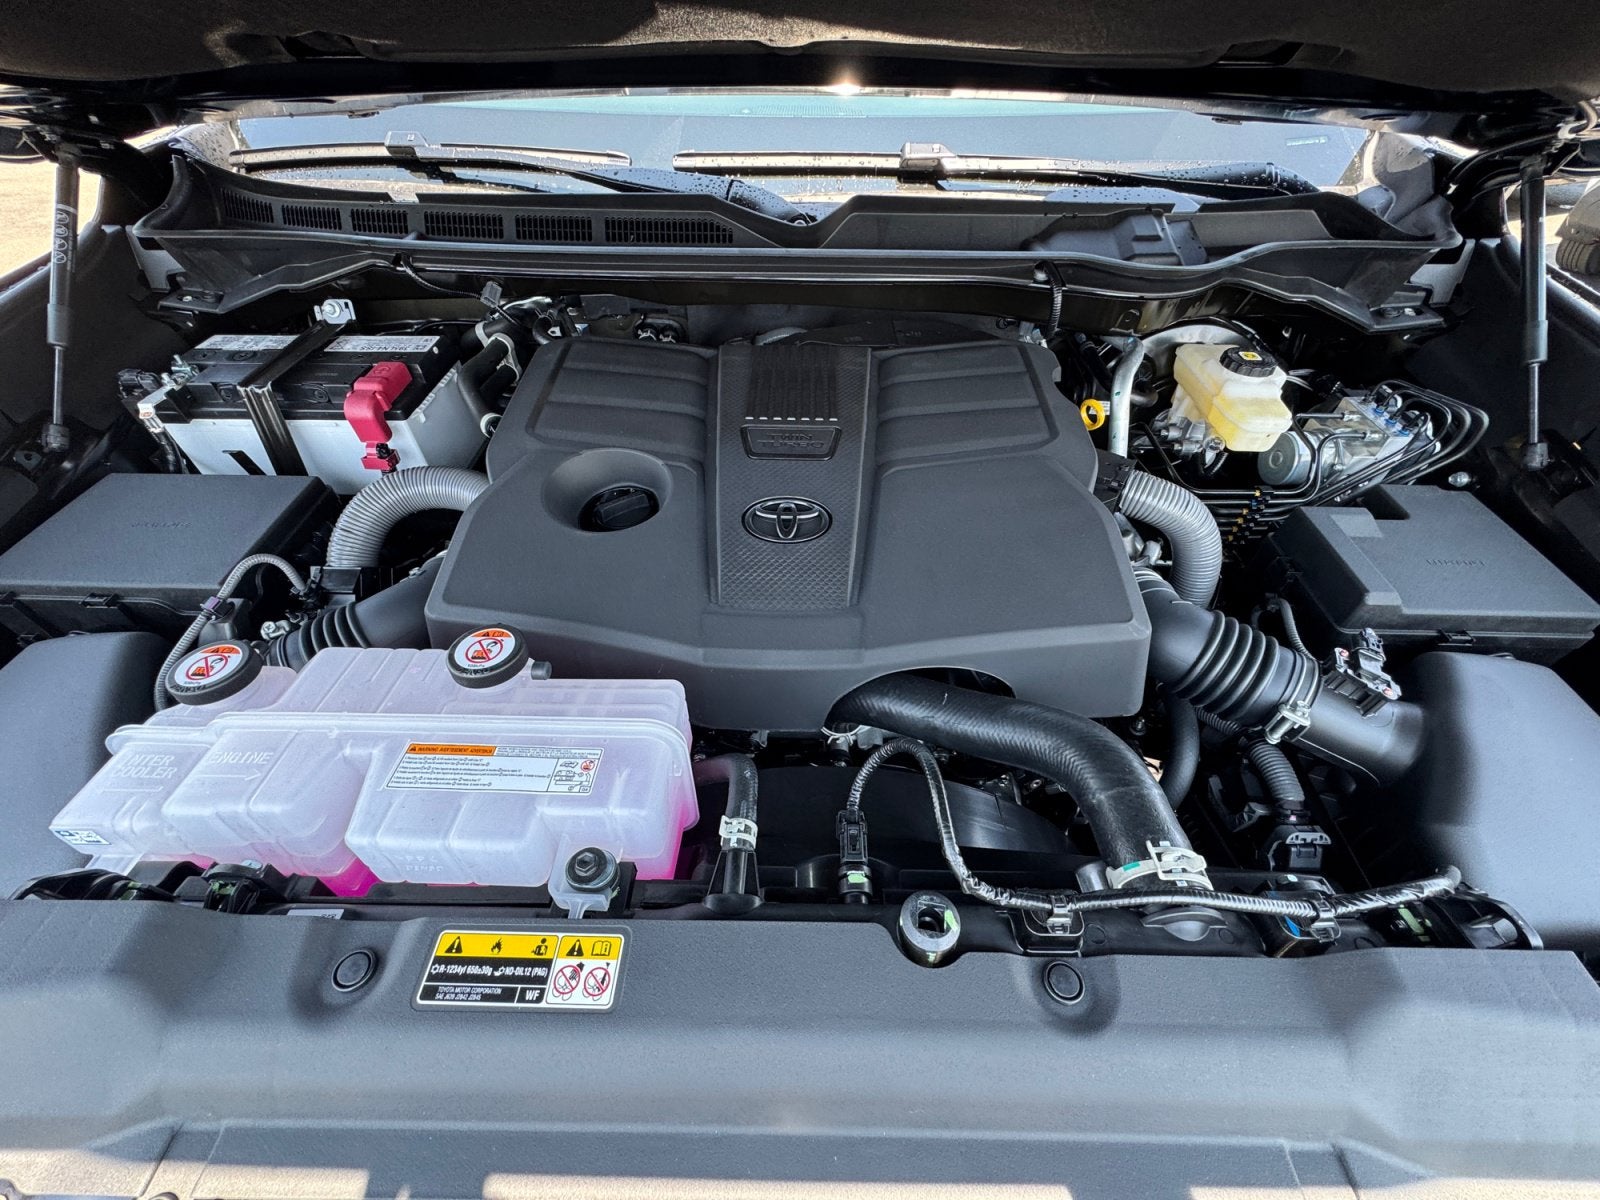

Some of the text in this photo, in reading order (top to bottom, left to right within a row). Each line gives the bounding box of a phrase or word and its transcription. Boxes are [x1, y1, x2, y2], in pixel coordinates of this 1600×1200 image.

[757, 440, 825, 448] TURBO
[123, 754, 176, 766] INTER
[209, 751, 275, 765] ENGINE
[113, 766, 178, 779] COOLER
[439, 965, 467, 975] R-1234yf
[455, 986, 471, 994] MOTOR
[471, 987, 503, 995] CORPORATION
[525, 989, 541, 1001] WF
